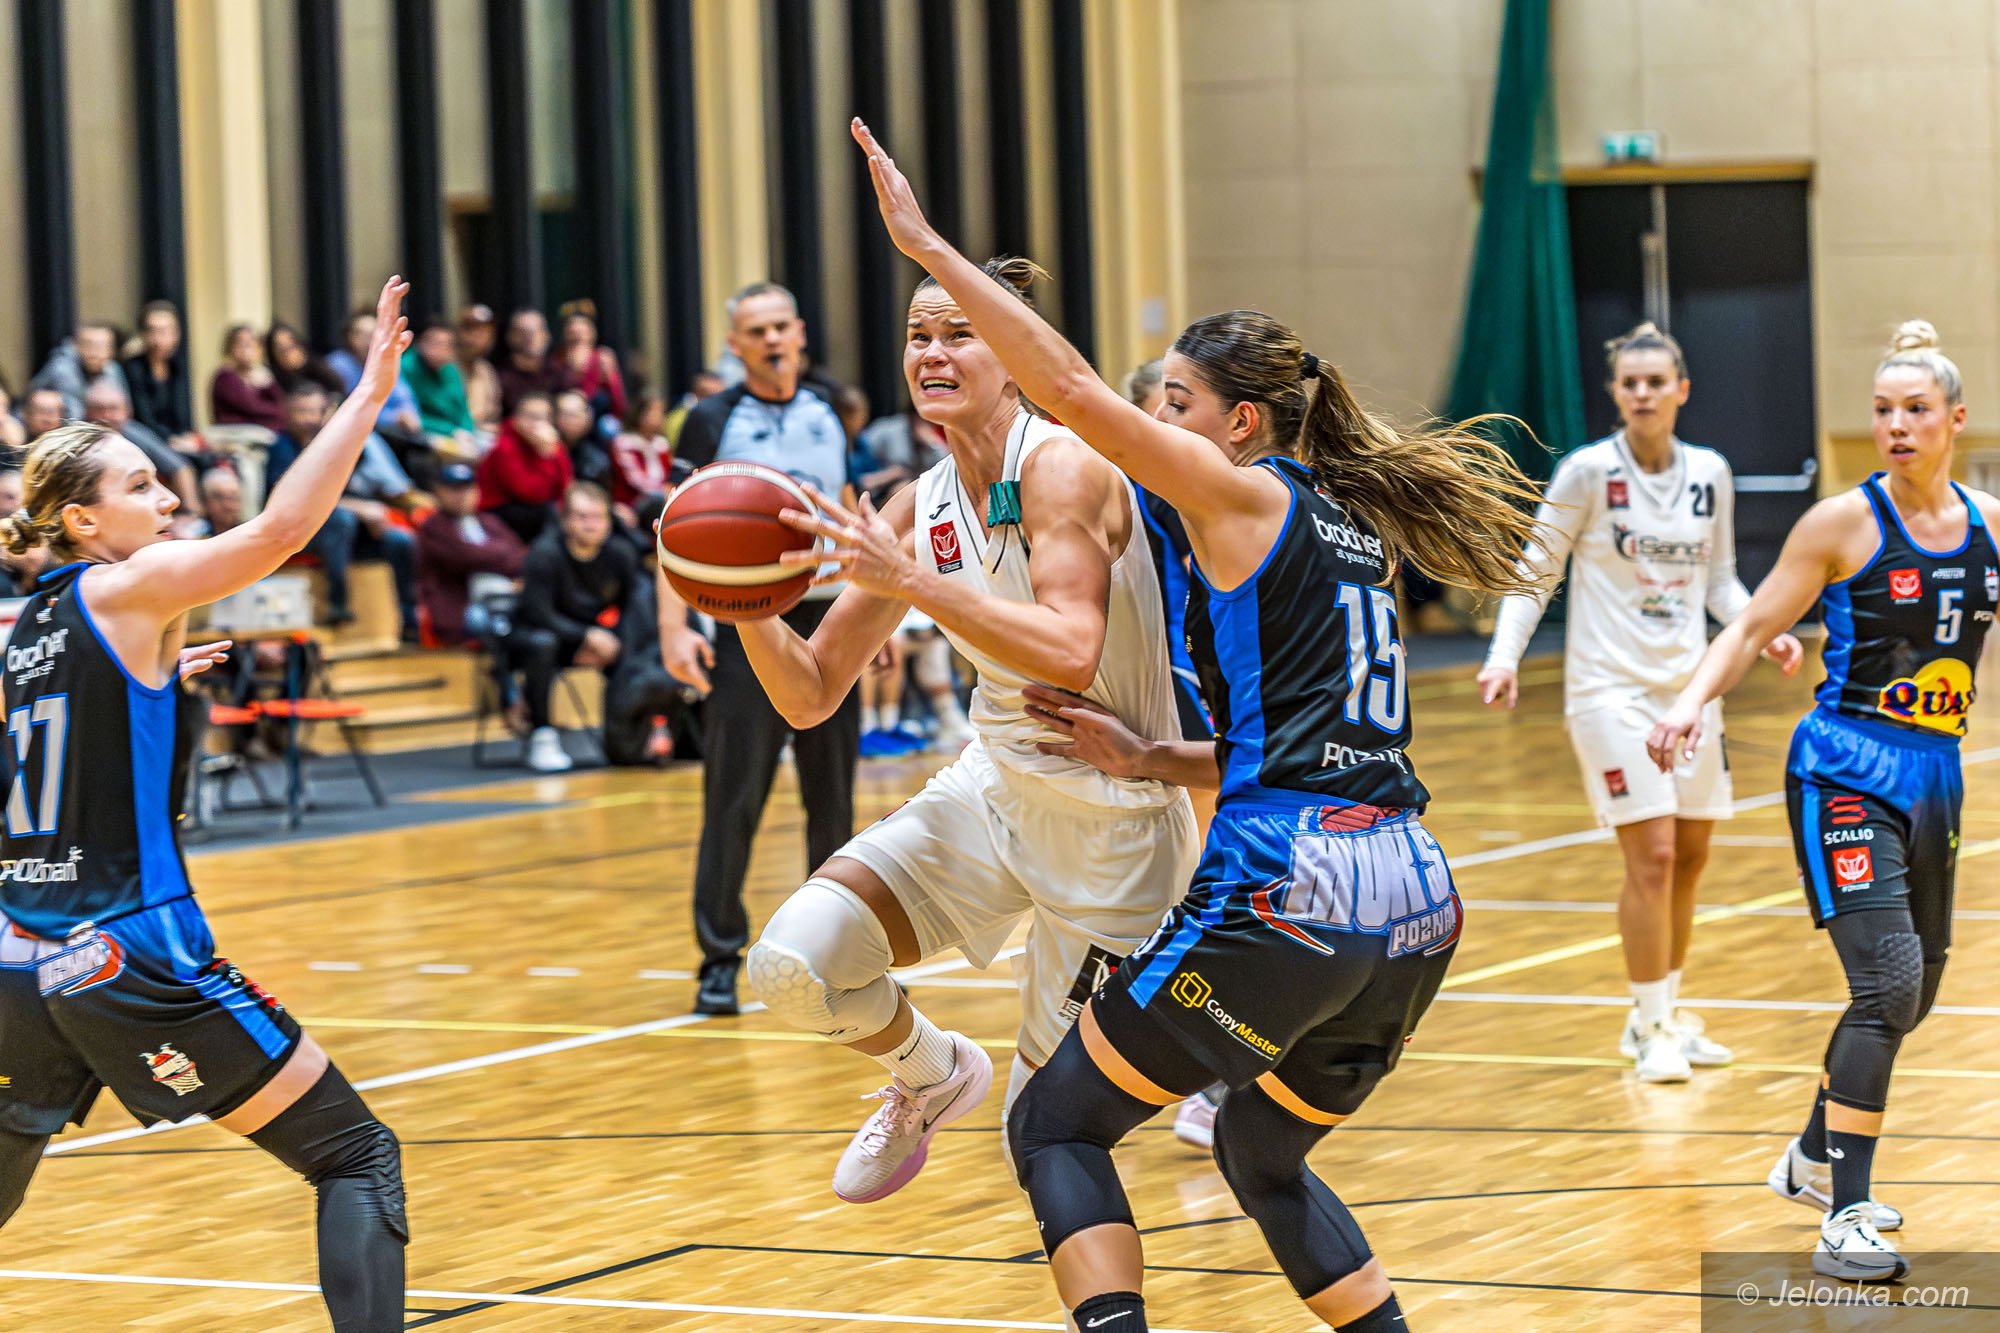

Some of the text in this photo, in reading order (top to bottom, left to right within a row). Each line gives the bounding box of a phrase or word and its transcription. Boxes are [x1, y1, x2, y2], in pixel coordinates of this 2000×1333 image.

[1311, 513, 1384, 558] brother
[1934, 588, 1964, 645] 5
[1333, 581, 1406, 734] 15
[5, 692, 69, 838] 17
[1824, 828, 1875, 845] SCALIO
[1207, 999, 1281, 1056] CopyMaster
